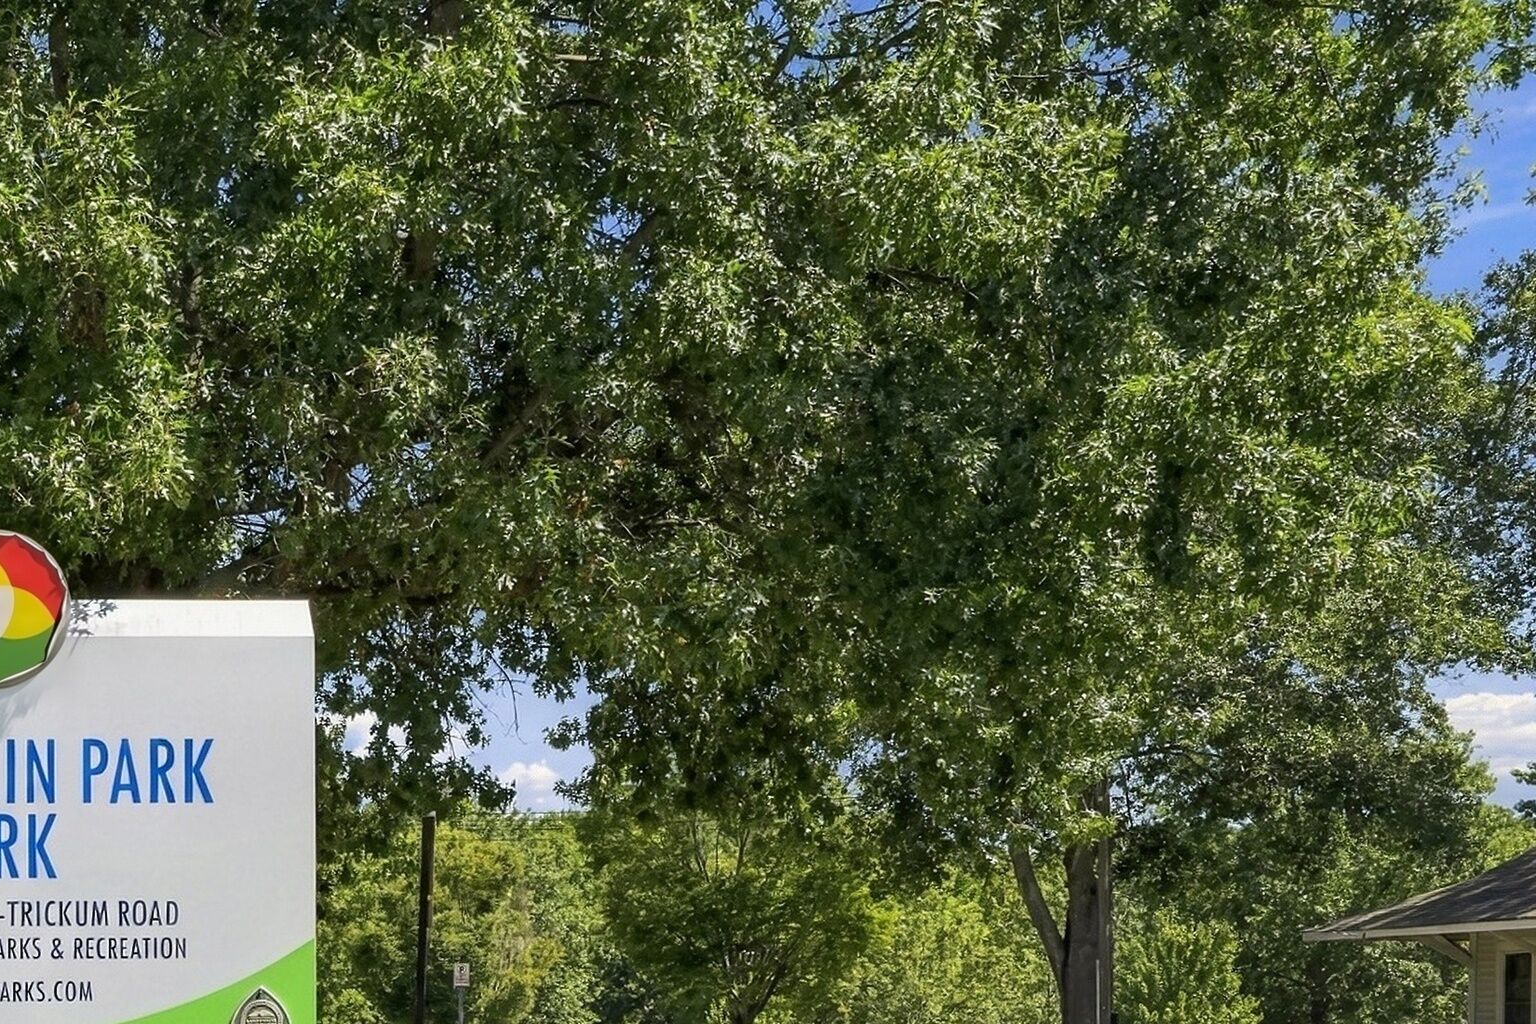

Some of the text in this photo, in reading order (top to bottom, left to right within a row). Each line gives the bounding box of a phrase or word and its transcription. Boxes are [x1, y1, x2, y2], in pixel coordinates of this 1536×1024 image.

[82, 738, 215, 804] PARK
[118, 901, 180, 926] ROAD
[50, 937, 65, 960] &
[73, 937, 187, 960] RECREATION
